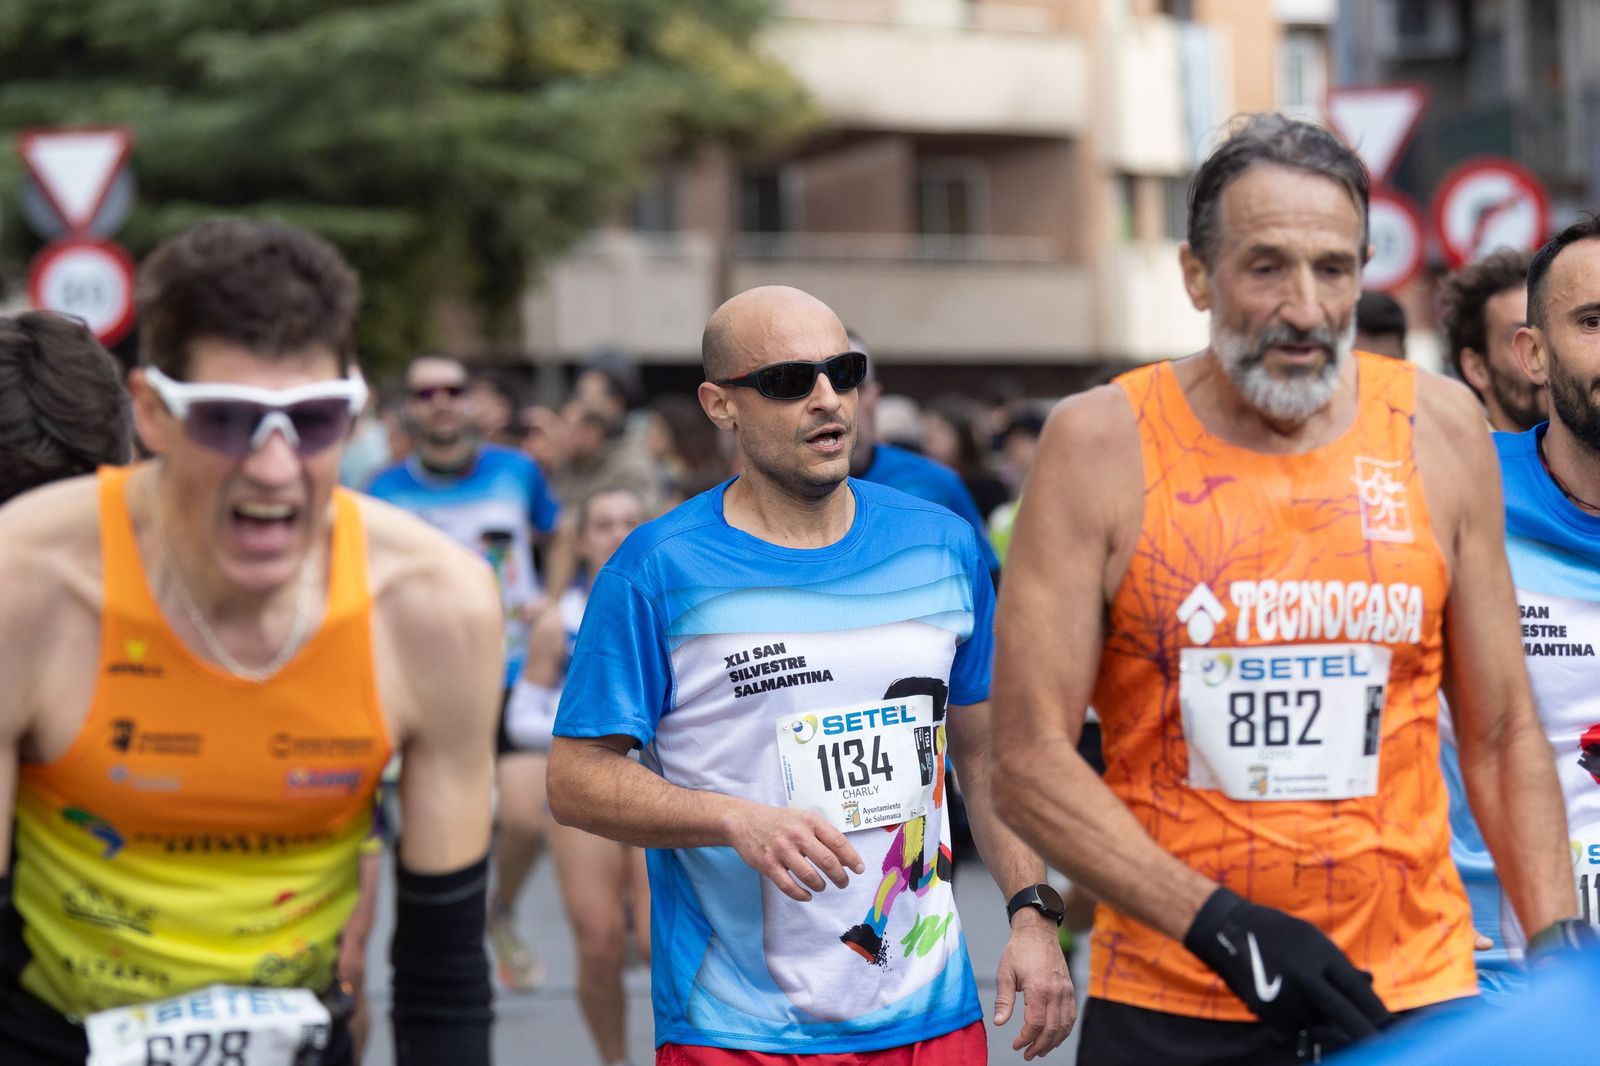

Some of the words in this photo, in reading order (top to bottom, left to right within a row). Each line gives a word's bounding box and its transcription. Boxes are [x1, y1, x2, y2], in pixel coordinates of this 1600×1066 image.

[1230, 579, 1423, 644] TECNOCASA
[1518, 605, 1549, 619] SAN
[1521, 624, 1567, 638] ESTRE
[723, 652, 750, 669] XLI
[752, 642, 787, 661] SAN
[728, 655, 807, 683] SILVESTRE
[1239, 653, 1369, 681] SETEL
[733, 669, 834, 698] SALMANTINA
[822, 704, 917, 736] SETEL
[1228, 689, 1322, 748] 862
[816, 735, 894, 792] 1134
[842, 784, 880, 800] CHARLY
[862, 802, 902, 815] Ayuntamiento
[864, 815, 873, 824] de
[873, 811, 902, 823] Salamanca
[156, 988, 298, 1023] SETEL
[146, 1029, 250, 1066] 628
